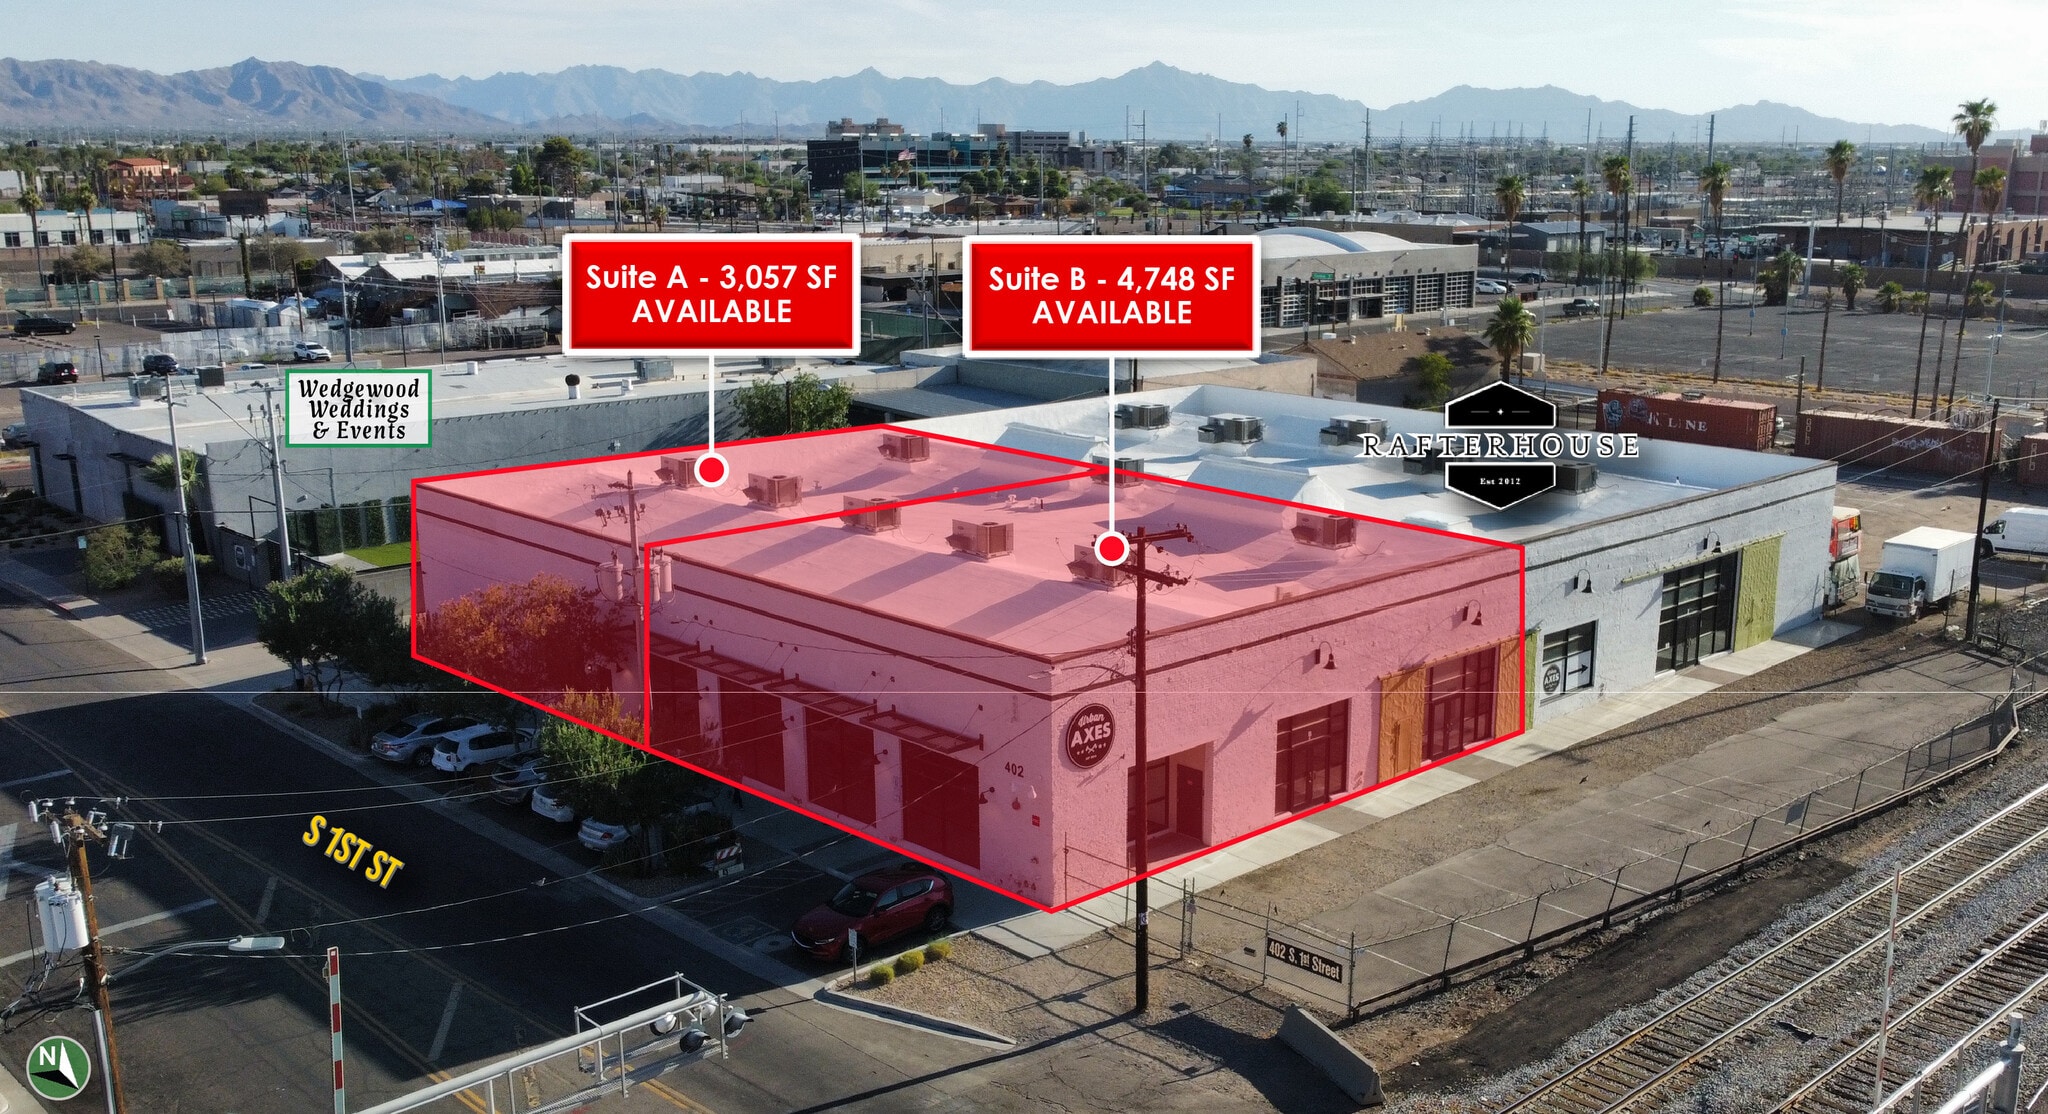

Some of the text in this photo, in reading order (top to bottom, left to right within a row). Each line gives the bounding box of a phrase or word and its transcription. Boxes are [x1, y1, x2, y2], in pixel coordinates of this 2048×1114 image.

[1071, 722, 1111, 748] AXES
[1004, 761, 1025, 778] 402
[1268, 941, 1340, 980] 402 S. 1st Street
